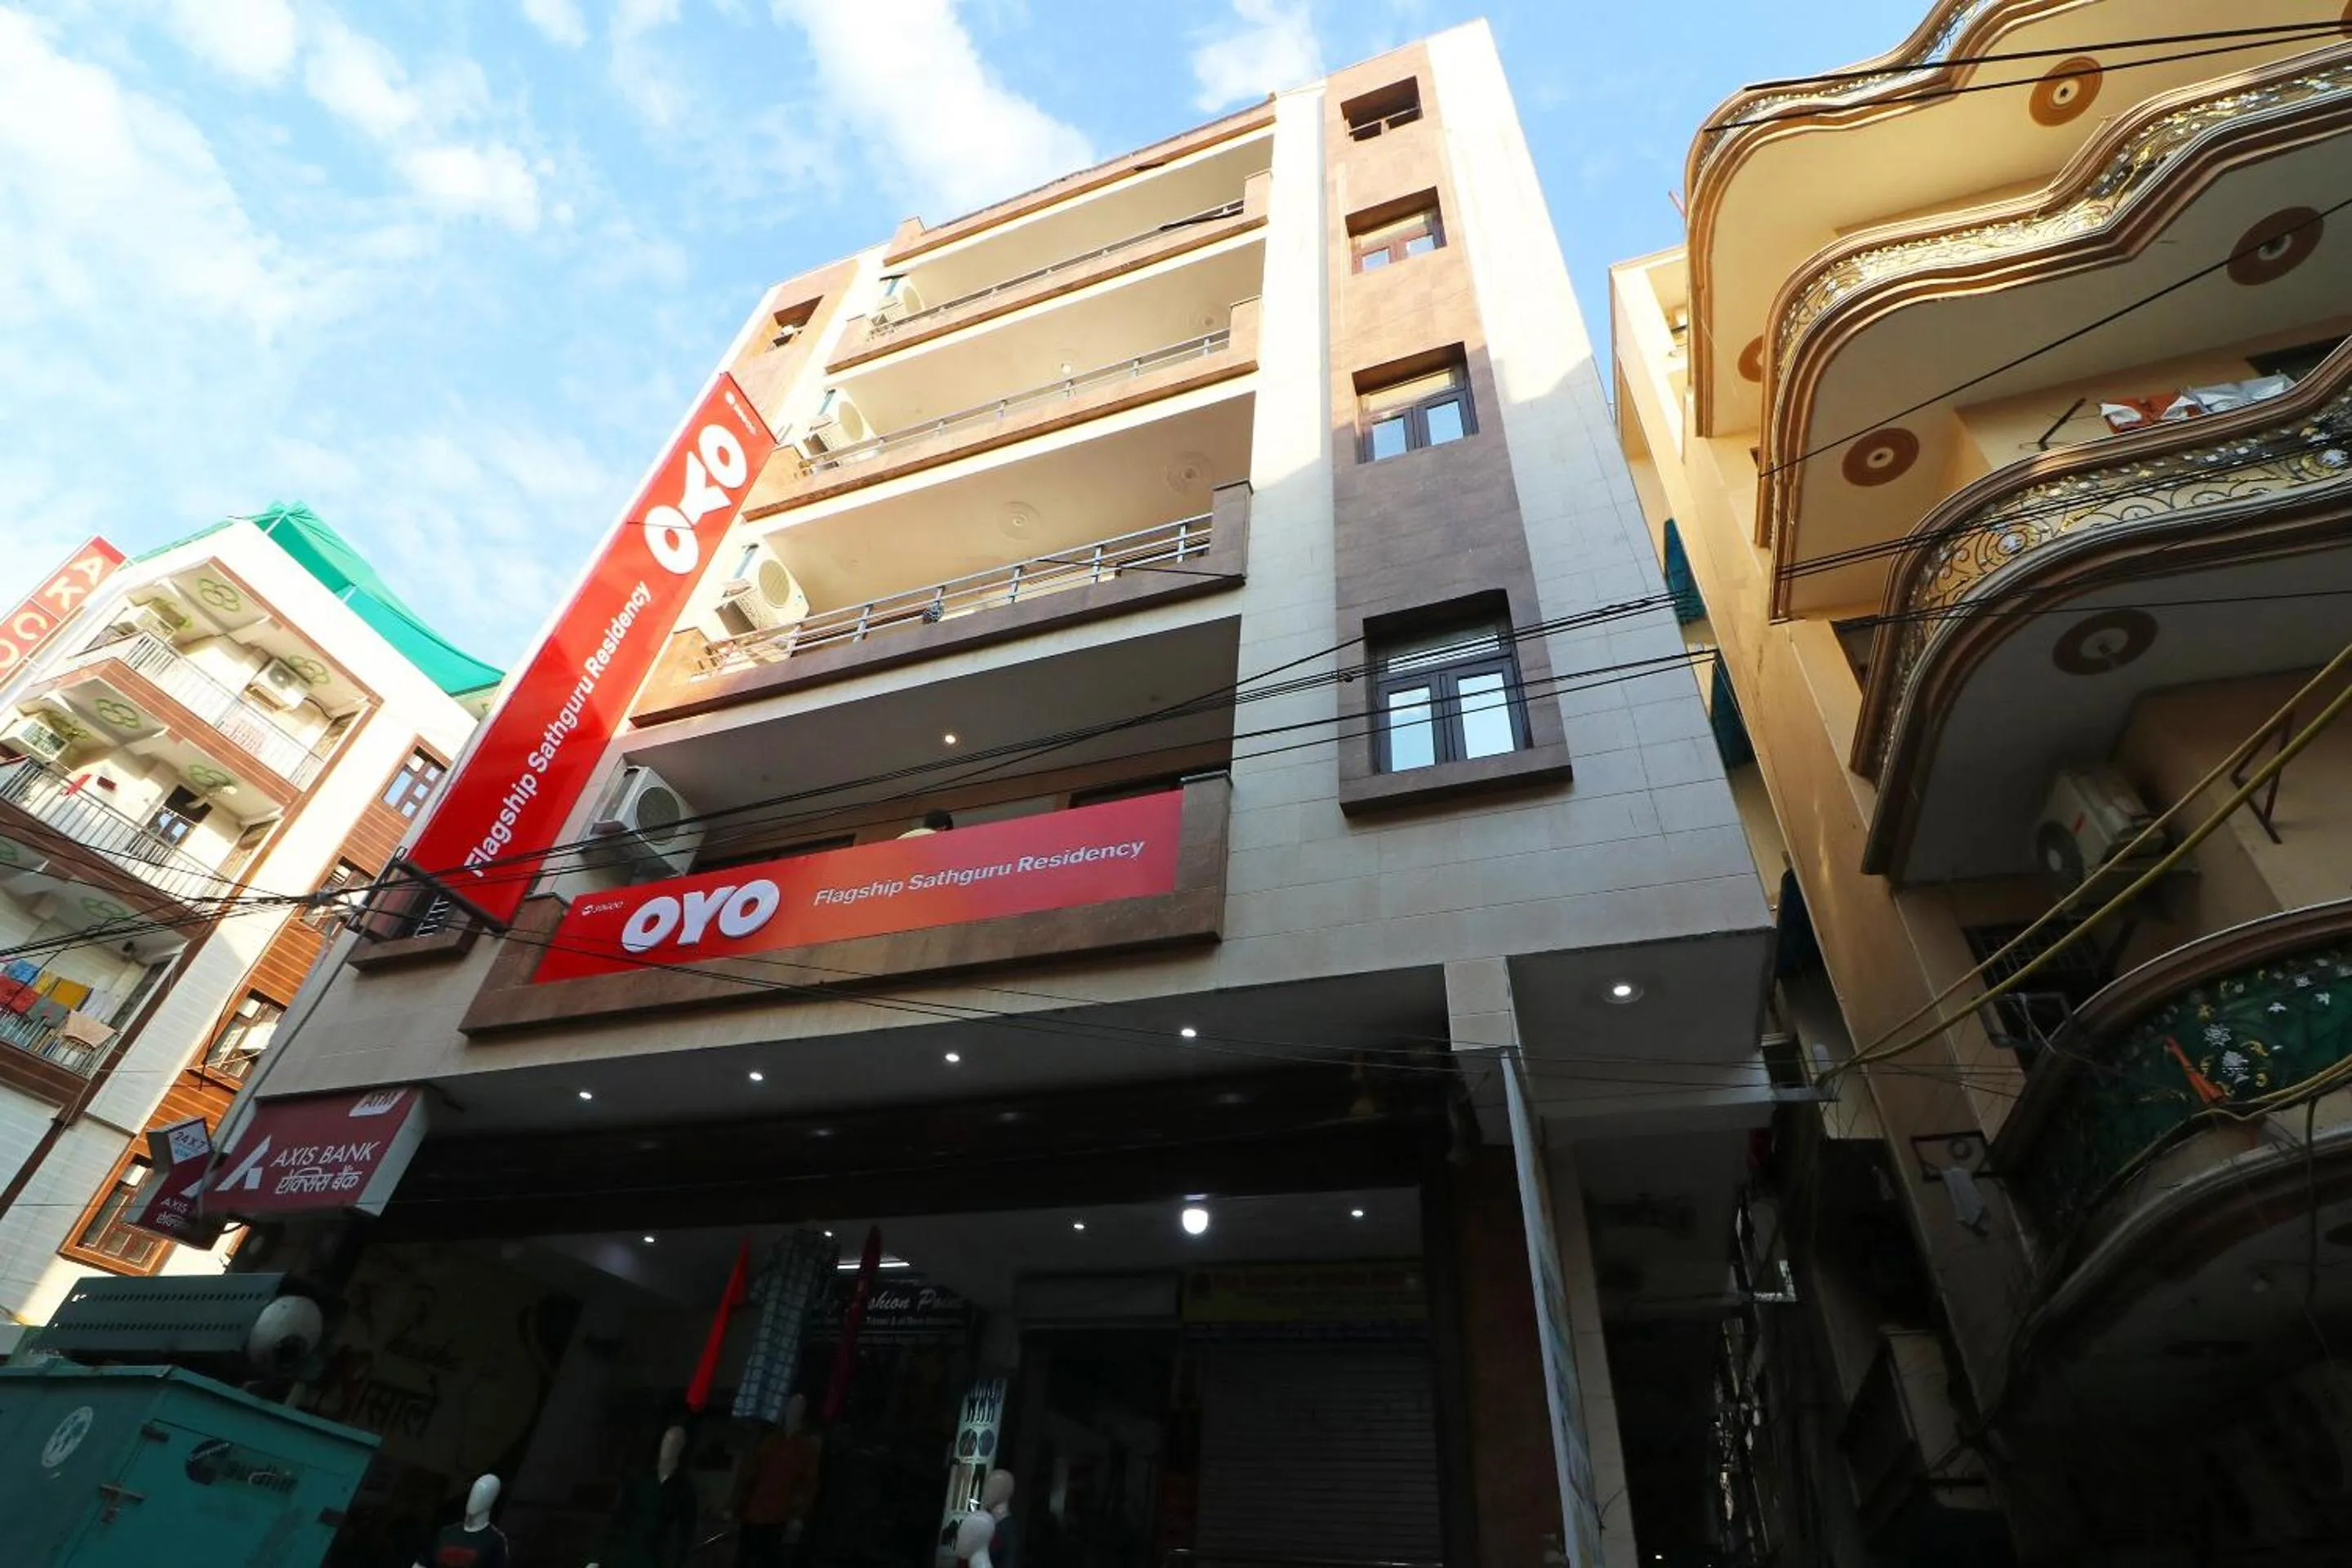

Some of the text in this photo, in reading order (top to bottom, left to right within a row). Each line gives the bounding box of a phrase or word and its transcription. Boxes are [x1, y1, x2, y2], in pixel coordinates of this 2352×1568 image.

[644, 424, 748, 575] OYO
[464, 580, 652, 877] Flagship Sathguru Residency
[813, 839, 1144, 906] Flagship Sathguru Residency
[621, 879, 780, 953] OYO
[270, 1141, 381, 1167] AXIS BANK
[160, 1196, 189, 1214] AXIS
